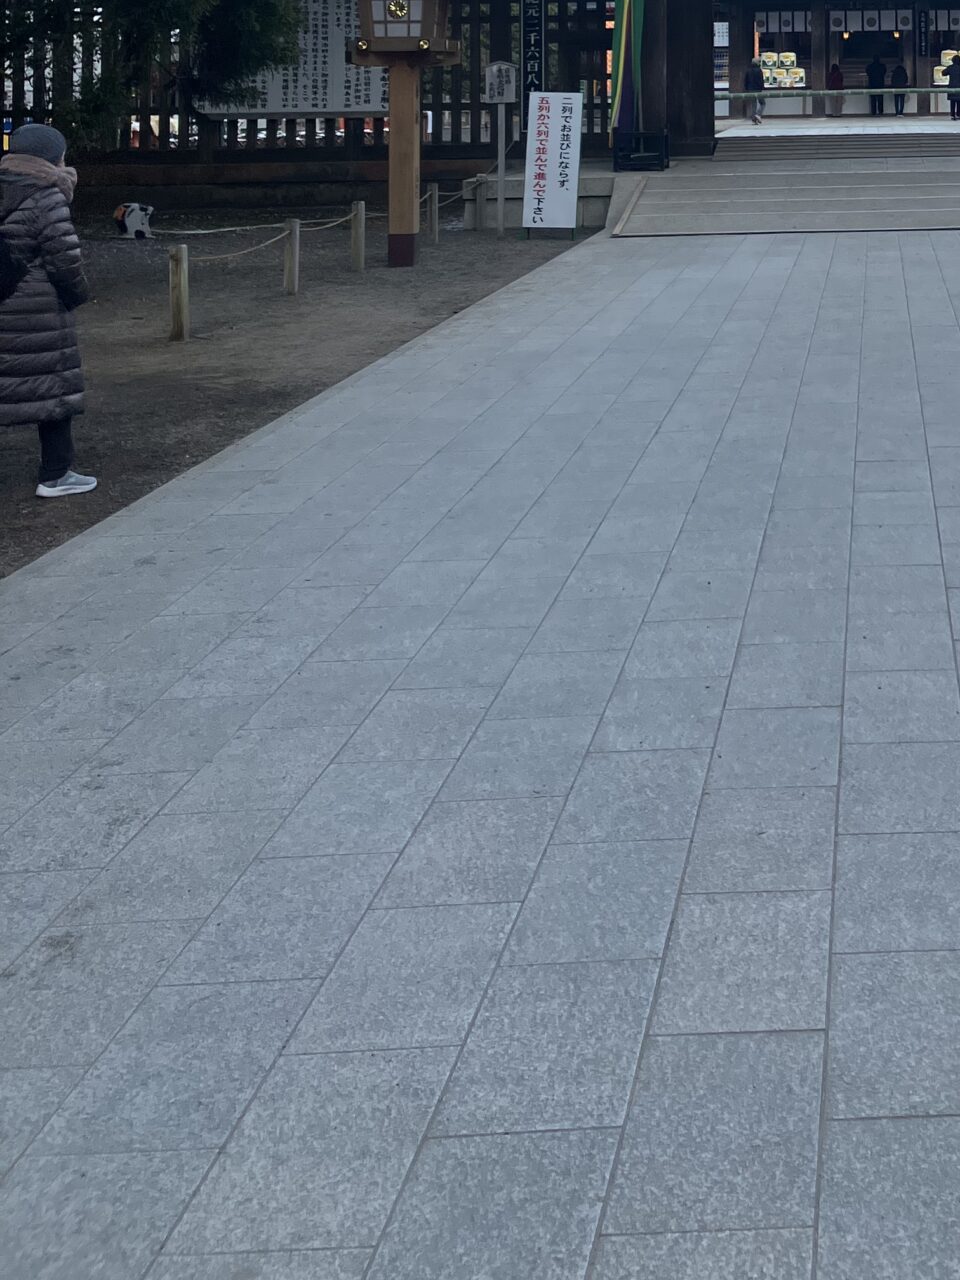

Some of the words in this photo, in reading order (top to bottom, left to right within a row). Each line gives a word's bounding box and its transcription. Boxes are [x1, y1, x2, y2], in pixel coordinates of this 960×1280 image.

[532, 96, 550, 224] 五列か六列で並んで進んで下さい
[557, 97, 573, 191] 二列でお並びにならず、
